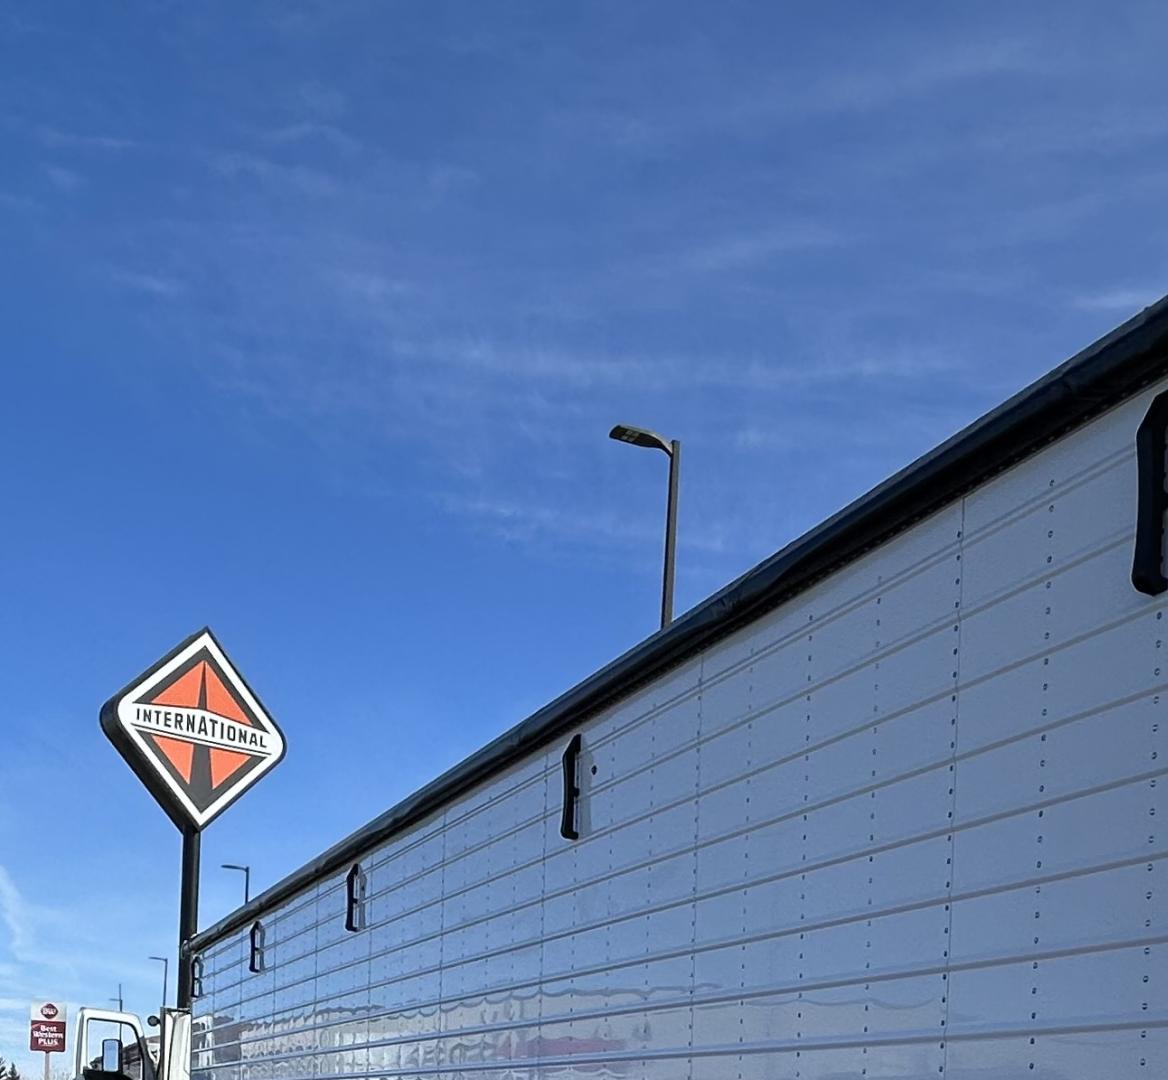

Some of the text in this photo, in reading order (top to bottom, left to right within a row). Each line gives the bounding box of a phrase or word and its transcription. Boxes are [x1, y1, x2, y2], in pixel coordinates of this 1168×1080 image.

[136, 707, 268, 749] INTERNATIONAL
[40, 1024, 57, 1032] Best
[33, 1030, 64, 1039] Western
[38, 1037, 59, 1046] PLUS
